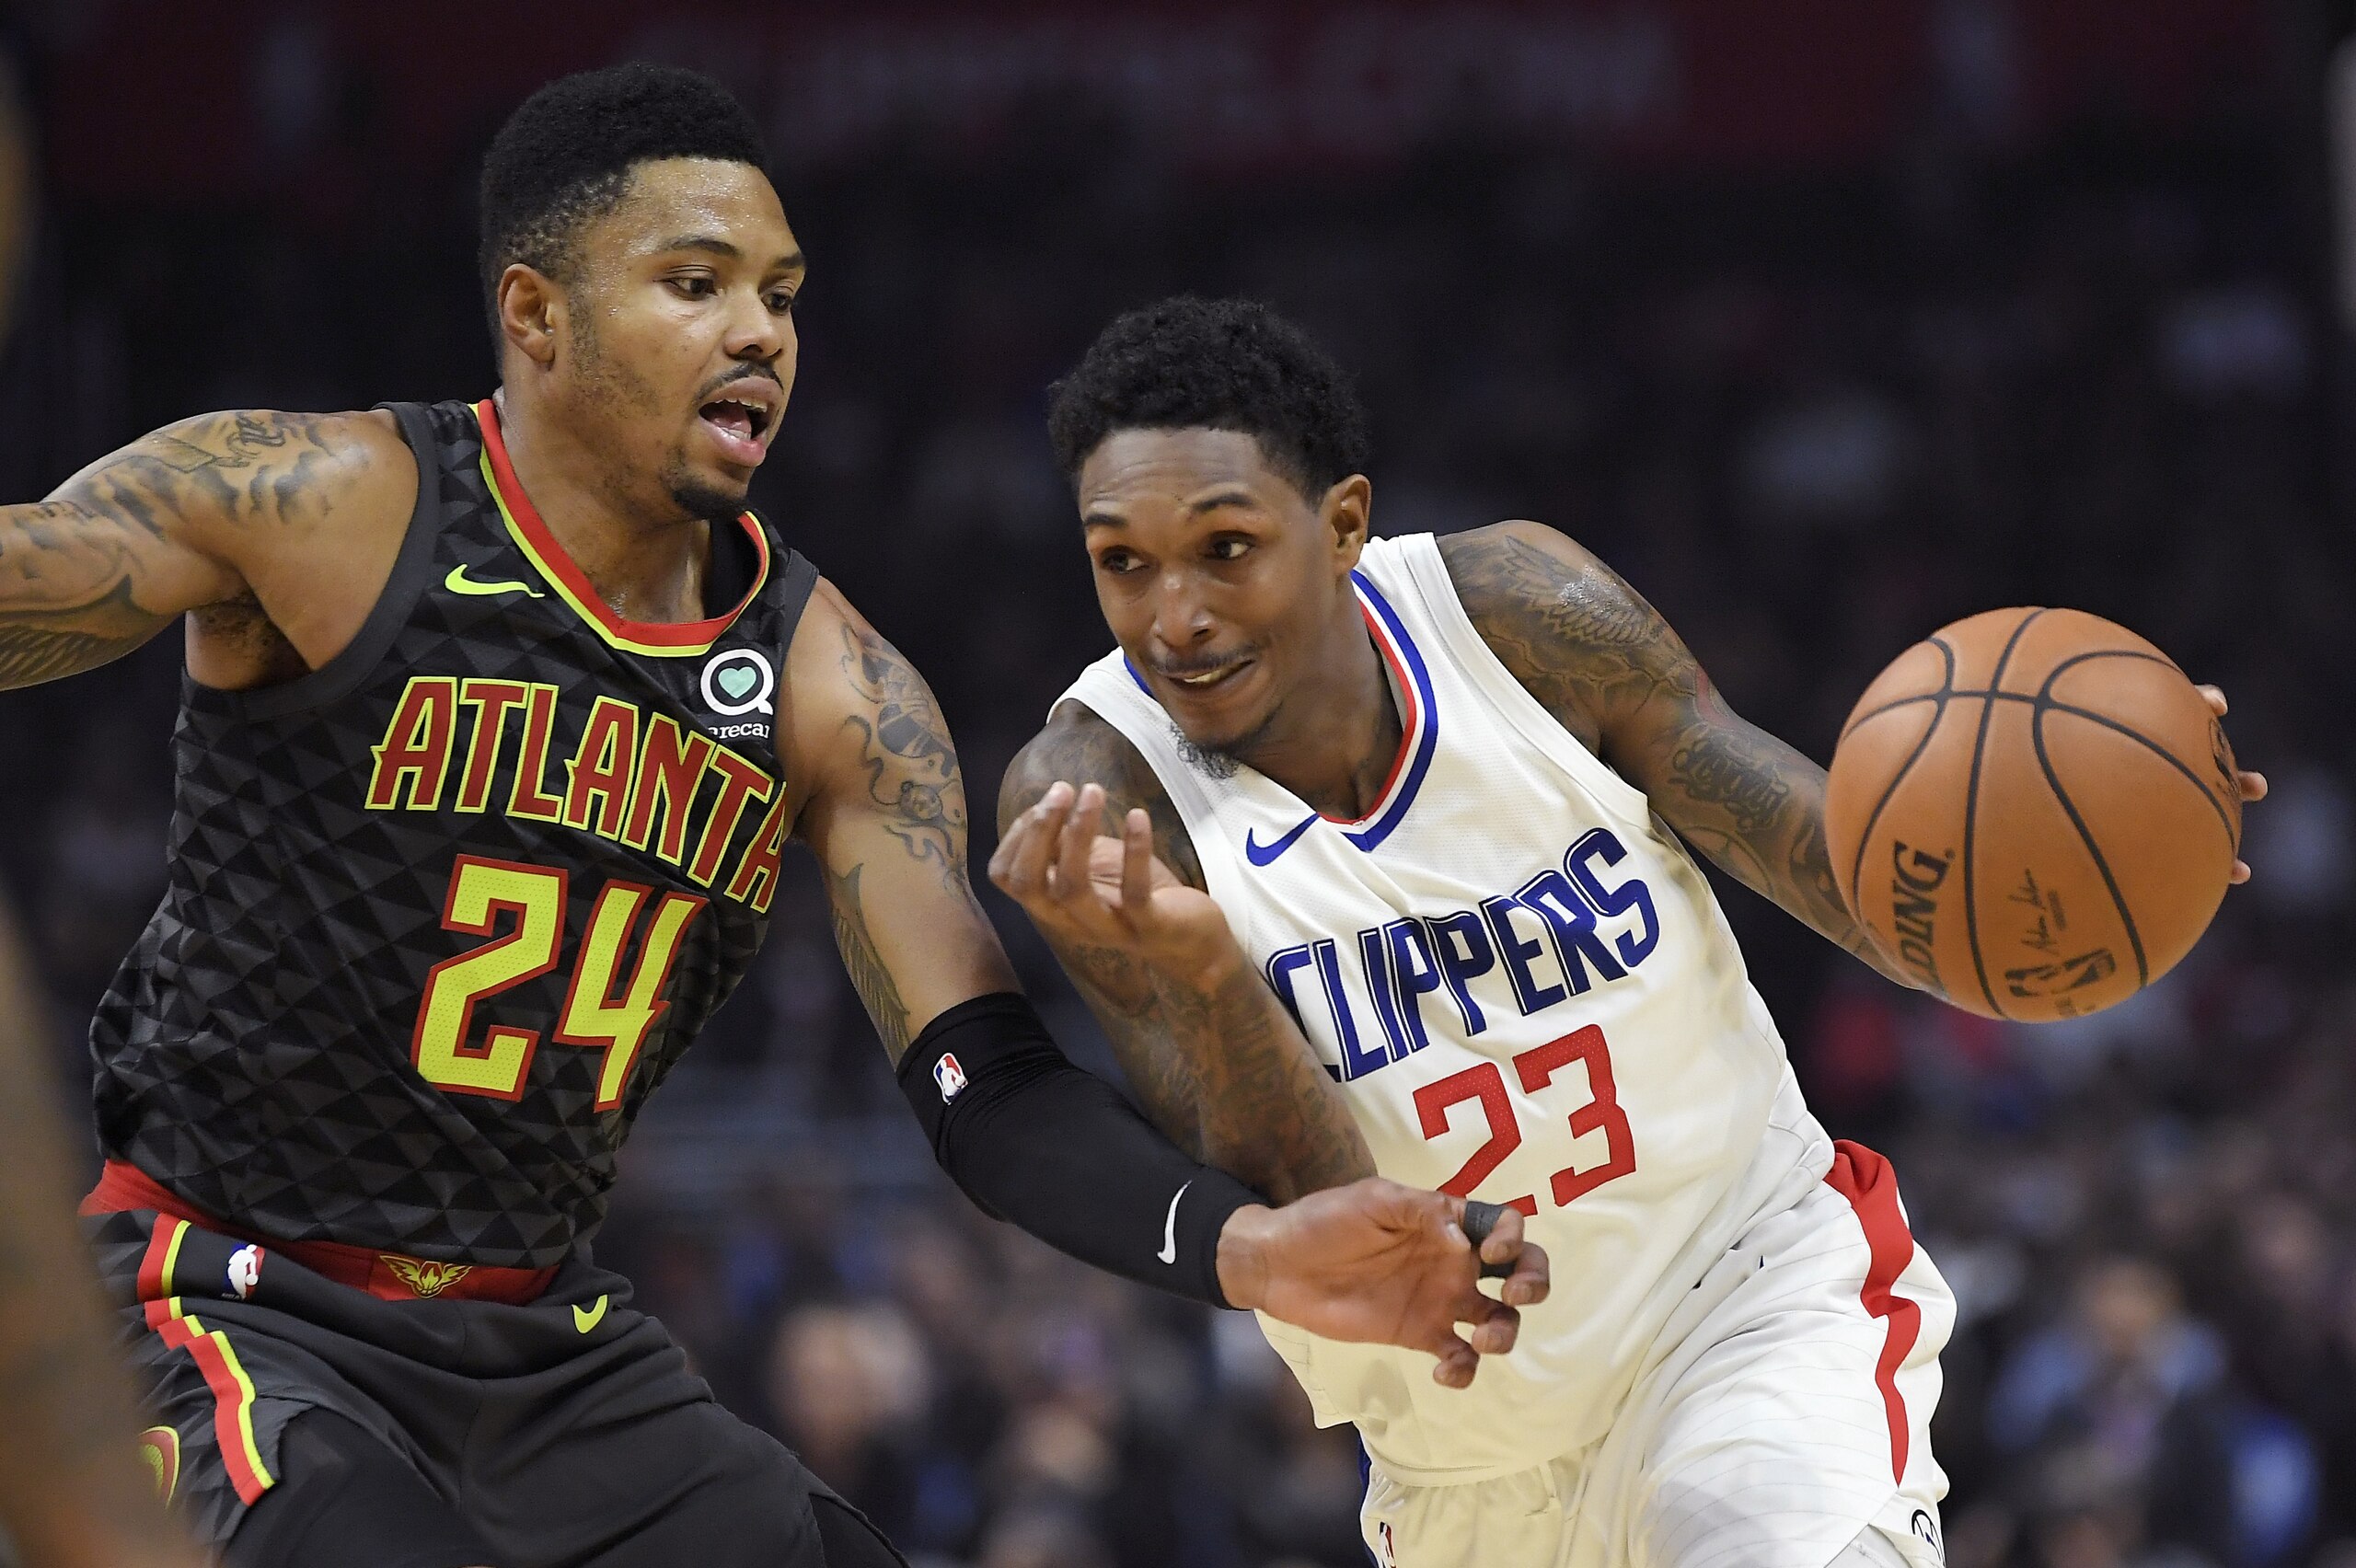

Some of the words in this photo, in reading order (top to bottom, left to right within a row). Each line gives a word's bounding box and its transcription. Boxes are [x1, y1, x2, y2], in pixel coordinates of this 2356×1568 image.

[365, 675, 788, 913] ATLANTA
[410, 853, 710, 1113] 24
[1265, 827, 1660, 1082] CLIPPERS
[1413, 1024, 1636, 1216] 23
